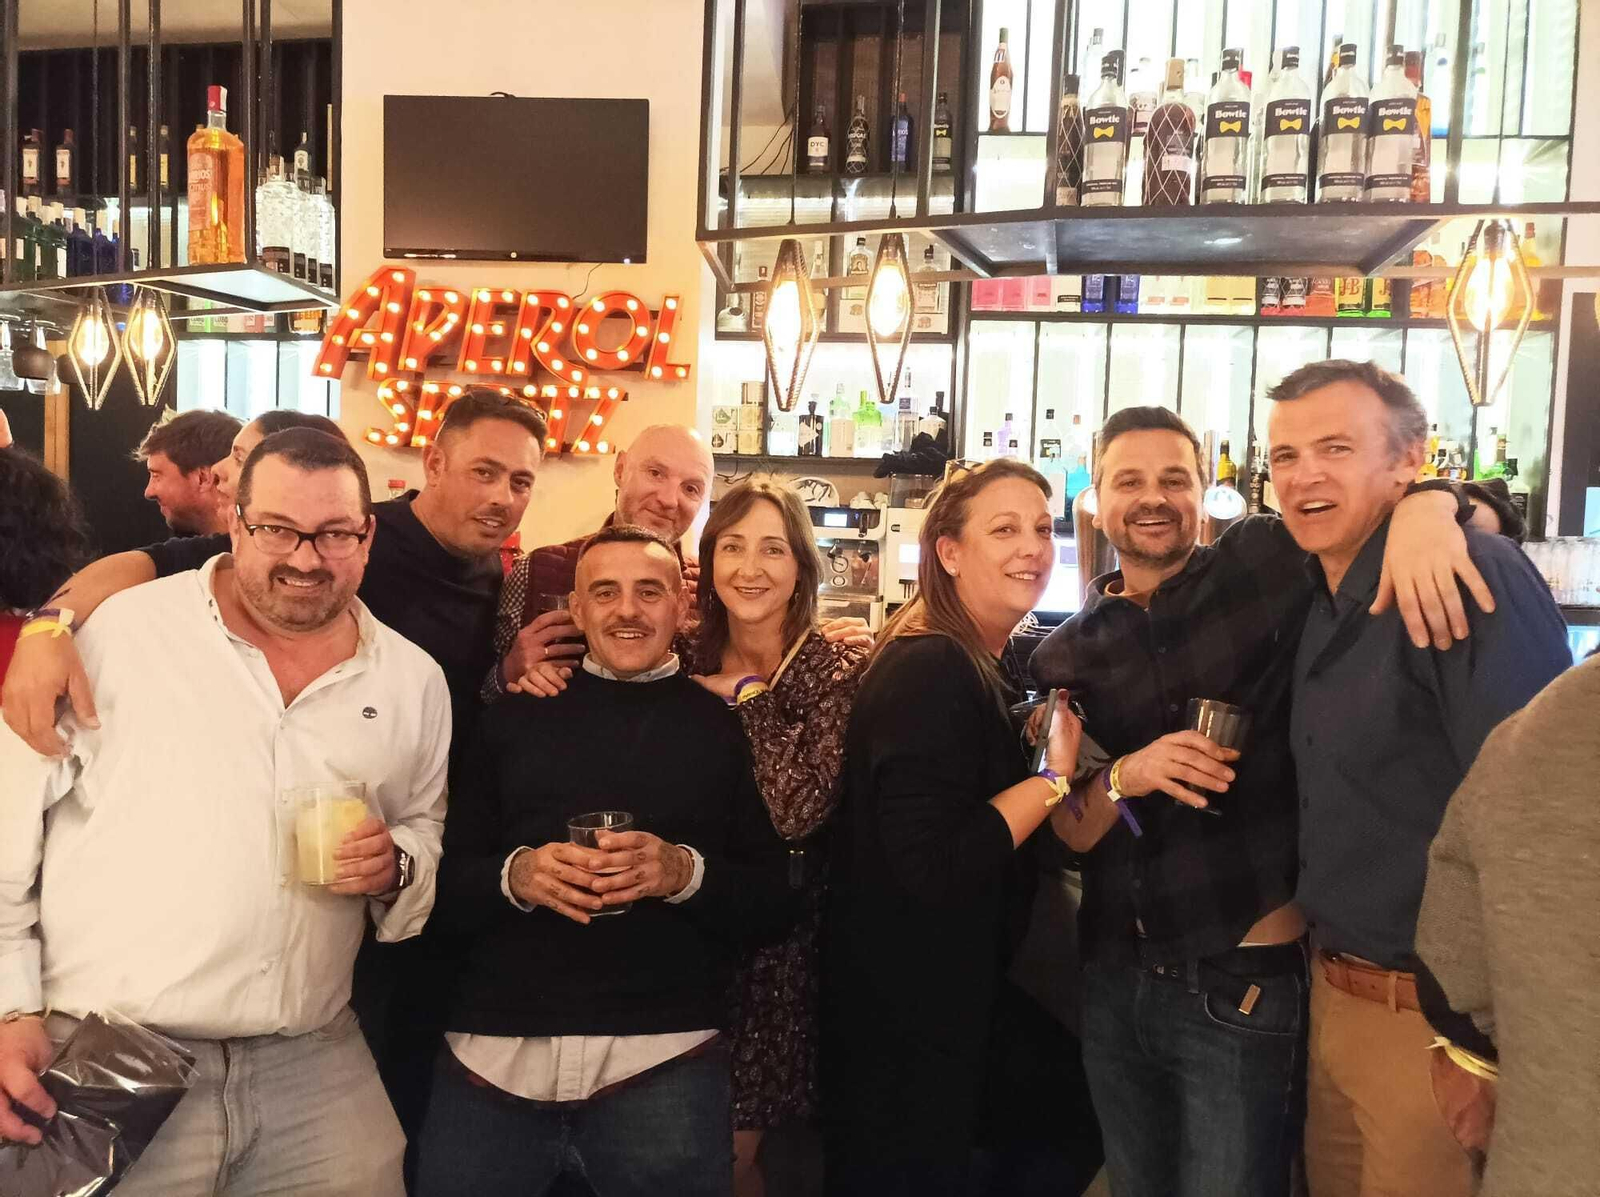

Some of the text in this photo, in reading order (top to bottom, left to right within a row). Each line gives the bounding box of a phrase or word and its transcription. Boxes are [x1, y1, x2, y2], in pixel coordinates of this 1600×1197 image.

[1215, 109, 1247, 119] Bowtie
[1275, 107, 1307, 117] Bowtie
[1332, 105, 1366, 116] Bowtie
[1378, 107, 1412, 117] Bowtie
[1089, 114, 1120, 125] Bowtie
[311, 265, 691, 386] APEROL
[363, 377, 628, 455] SPTZ
